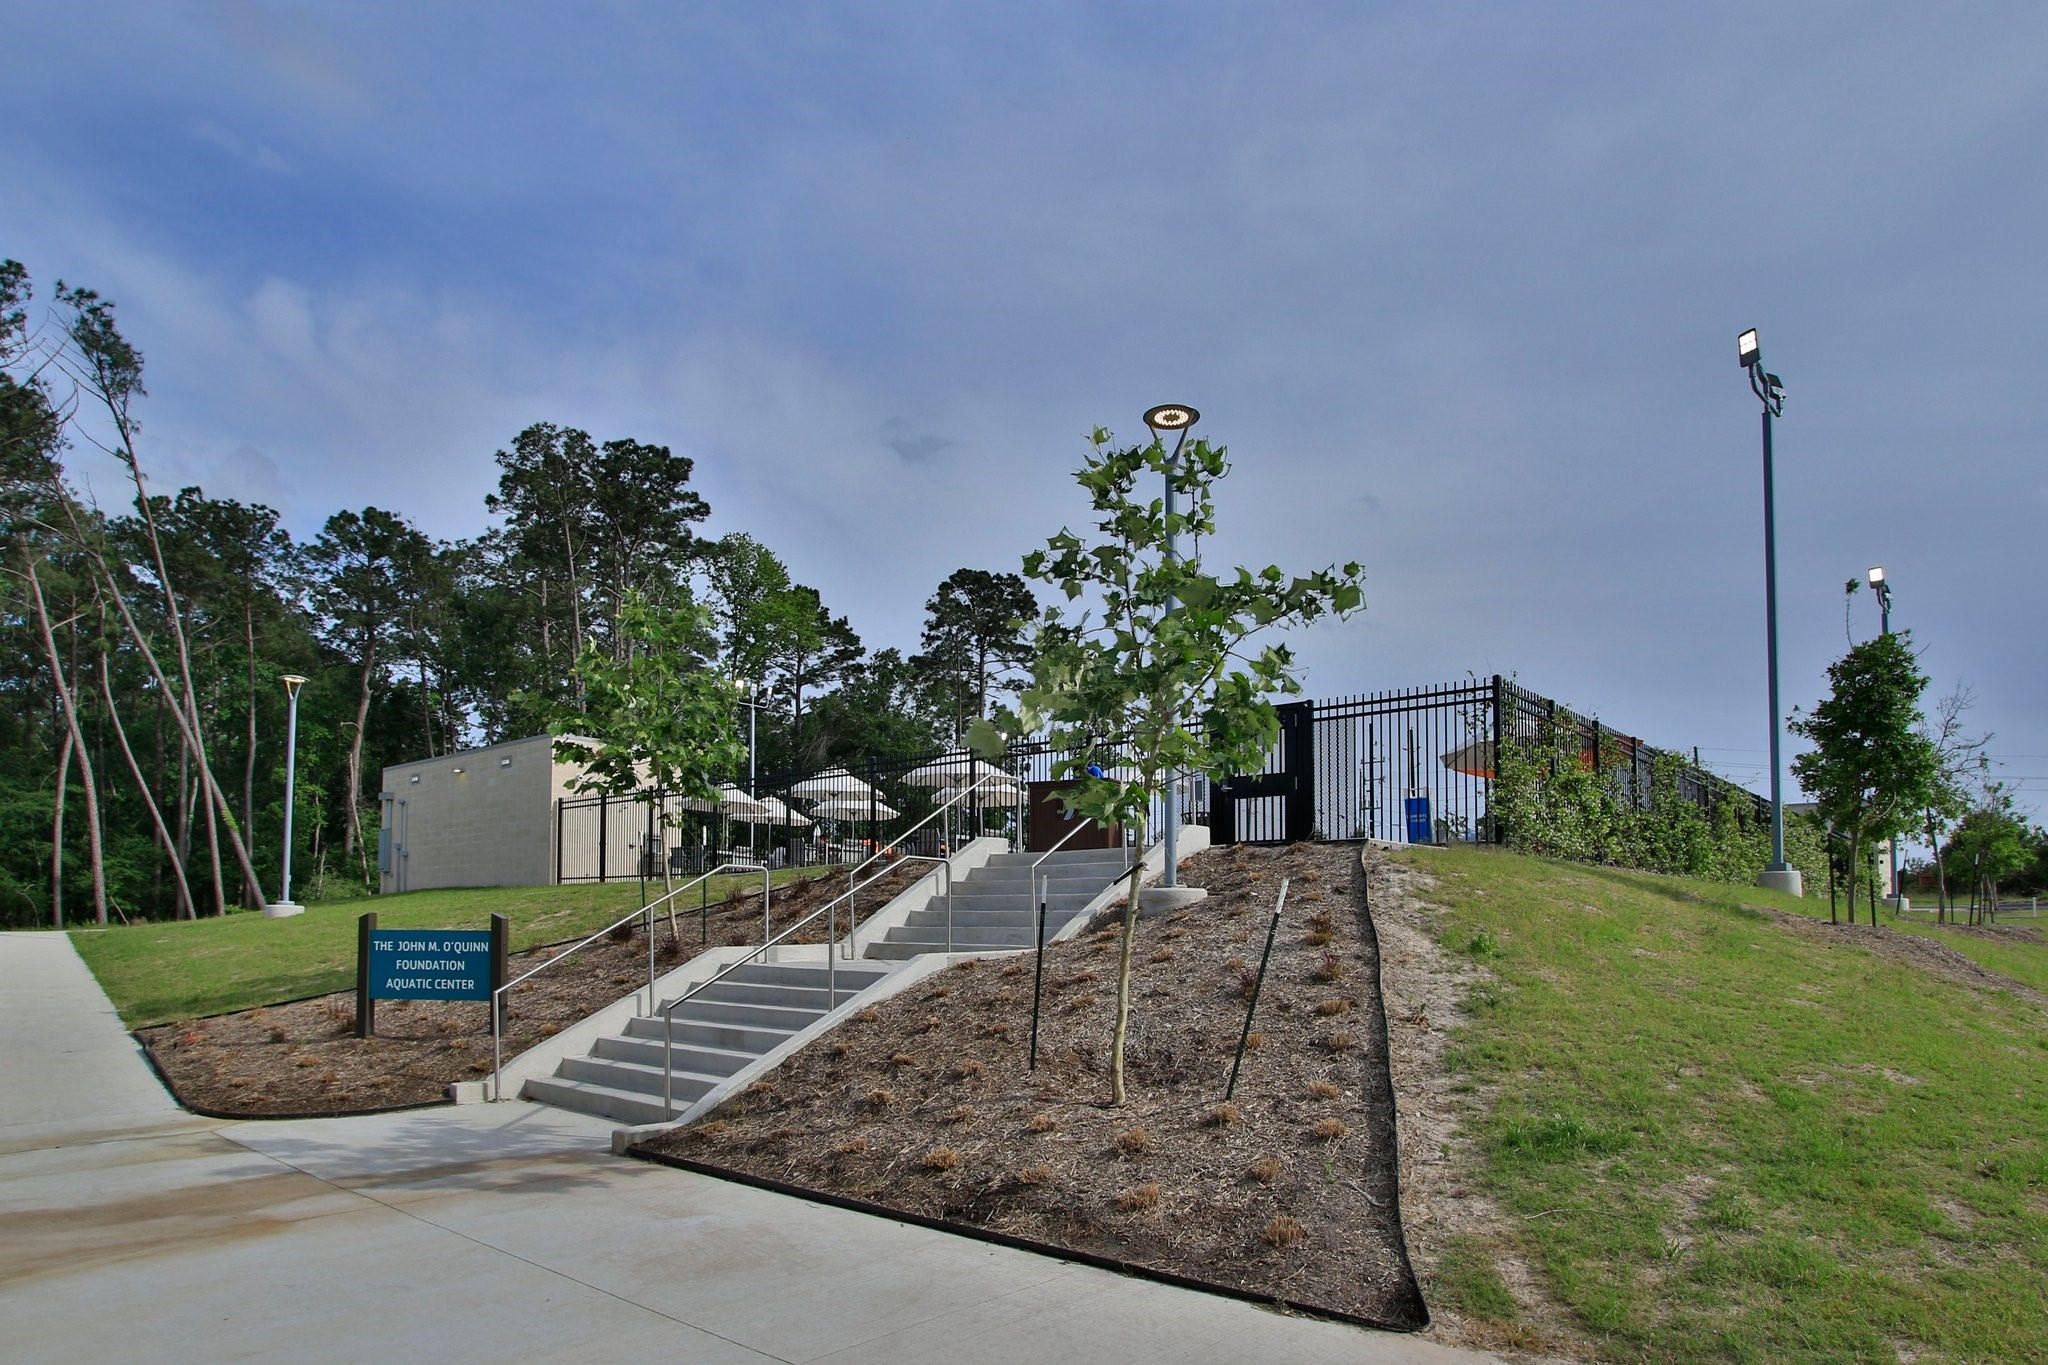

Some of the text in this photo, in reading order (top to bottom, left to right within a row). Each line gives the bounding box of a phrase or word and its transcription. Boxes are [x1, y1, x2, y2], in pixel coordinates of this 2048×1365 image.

[374, 941, 489, 954] THE JOHN M. O'QUINN
[396, 960, 465, 971] FOUNDATION
[386, 978, 475, 991] AQUATIC CENTER
